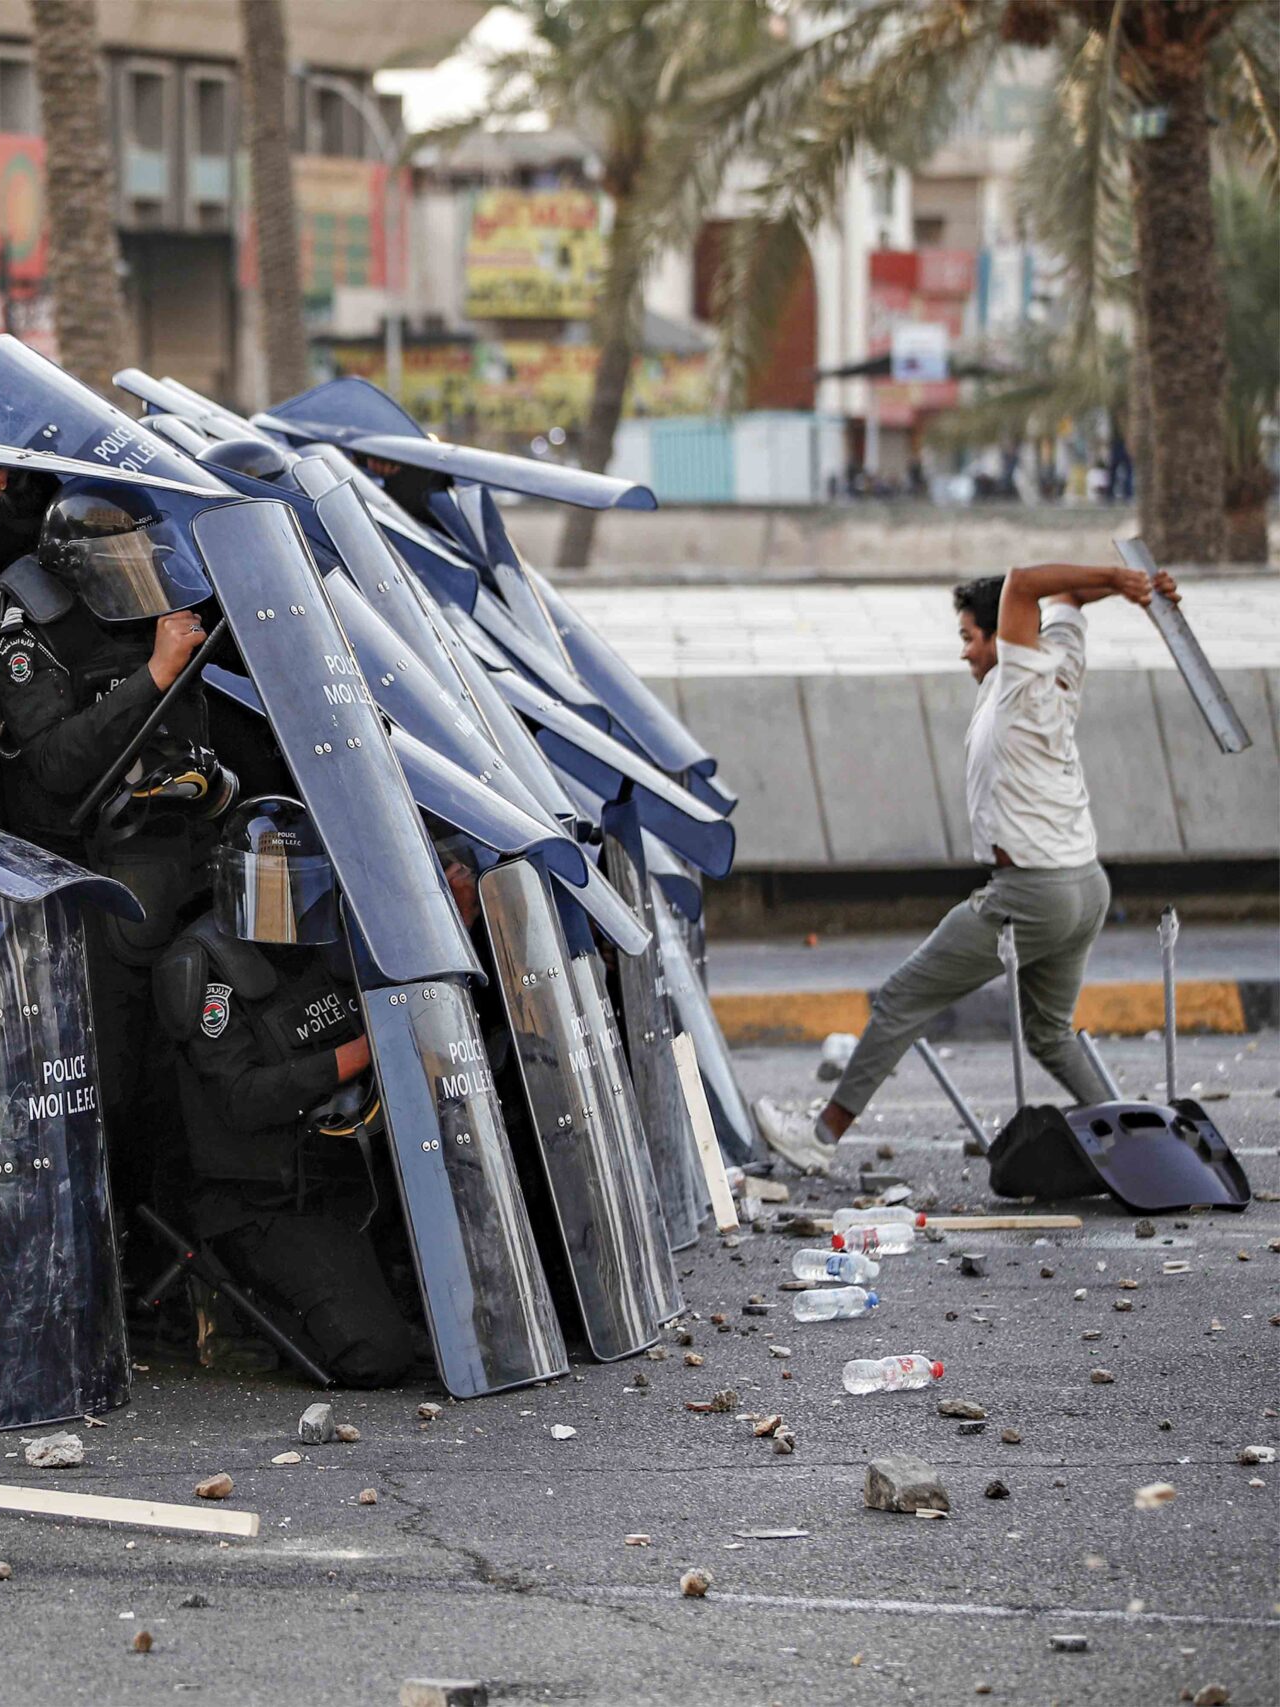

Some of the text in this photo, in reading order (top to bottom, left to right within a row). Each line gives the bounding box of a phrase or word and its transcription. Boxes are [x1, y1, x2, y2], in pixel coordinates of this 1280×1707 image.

[322, 684, 356, 705] MOI
[42, 1055, 87, 1085] POLICE
[441, 1072, 473, 1099] MOI
[28, 1085, 96, 1121] MOI L.E.F.C
